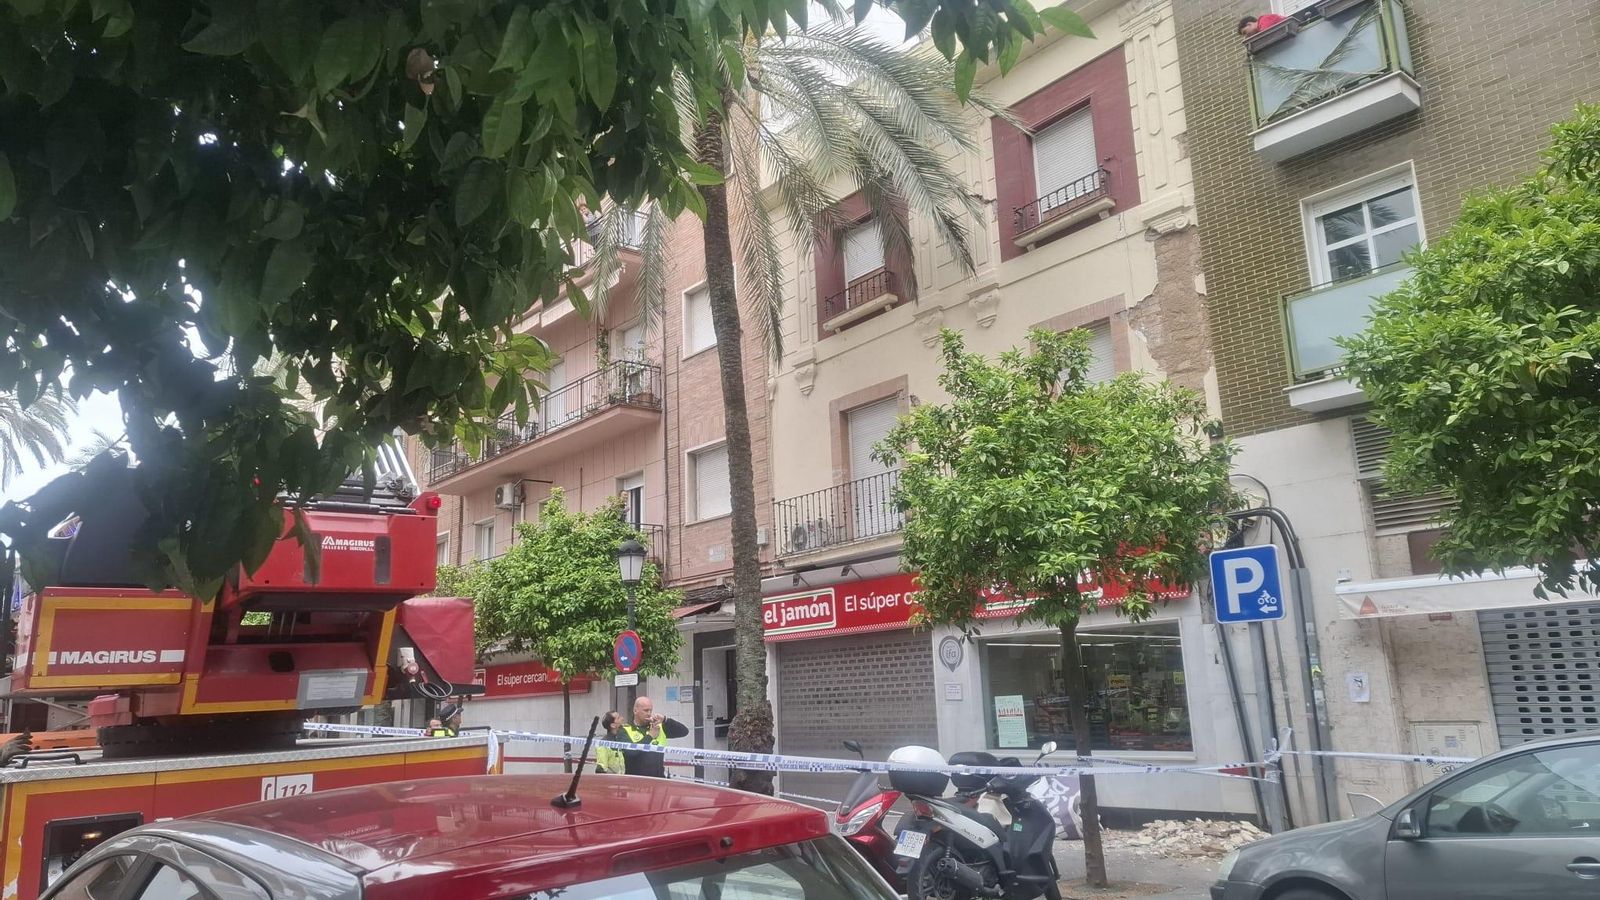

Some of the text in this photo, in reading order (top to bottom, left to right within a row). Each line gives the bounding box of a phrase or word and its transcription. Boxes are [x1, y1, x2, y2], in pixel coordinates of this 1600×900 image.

[335, 538, 375, 547] MAGIRUS
[1223, 557, 1265, 614] P
[764, 594, 831, 627] el jamón
[844, 595, 857, 612] El
[860, 592, 900, 613] súper
[60, 649, 157, 665] MAGIRUS
[497, 674, 504, 686] El
[504, 673, 523, 688] súper
[524, 671, 548, 684] cercan
[281, 783, 308, 797] 112
